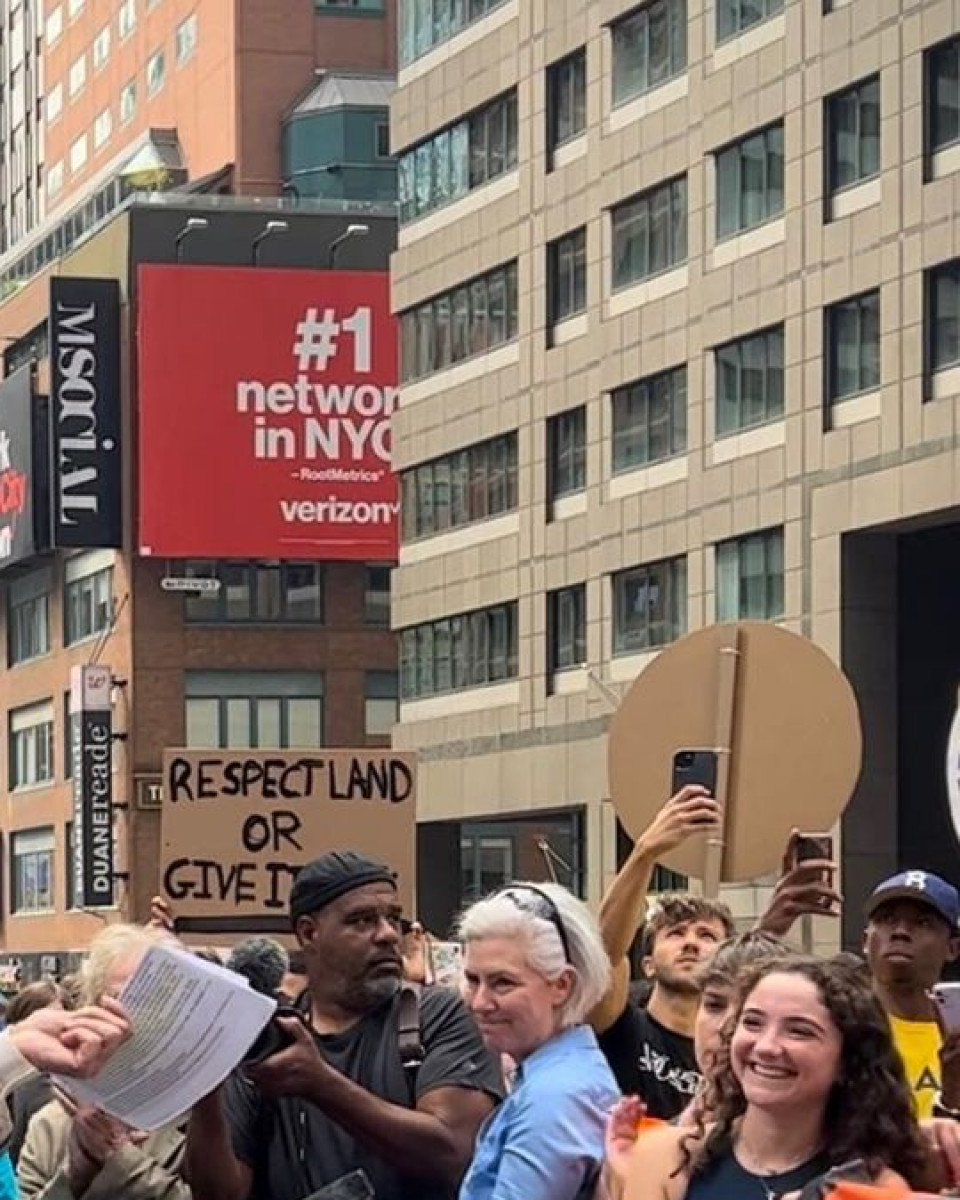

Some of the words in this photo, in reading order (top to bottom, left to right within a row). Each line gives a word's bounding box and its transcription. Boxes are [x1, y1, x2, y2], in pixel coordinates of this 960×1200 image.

[292, 306, 371, 373] #1
[236, 374, 401, 417] networ
[254, 417, 296, 459] in
[280, 496, 390, 523] verizon
[169, 758, 324, 802] RESPECT
[329, 758, 413, 803] LAND
[242, 811, 303, 852] OR
[164, 858, 257, 906] GIVE
